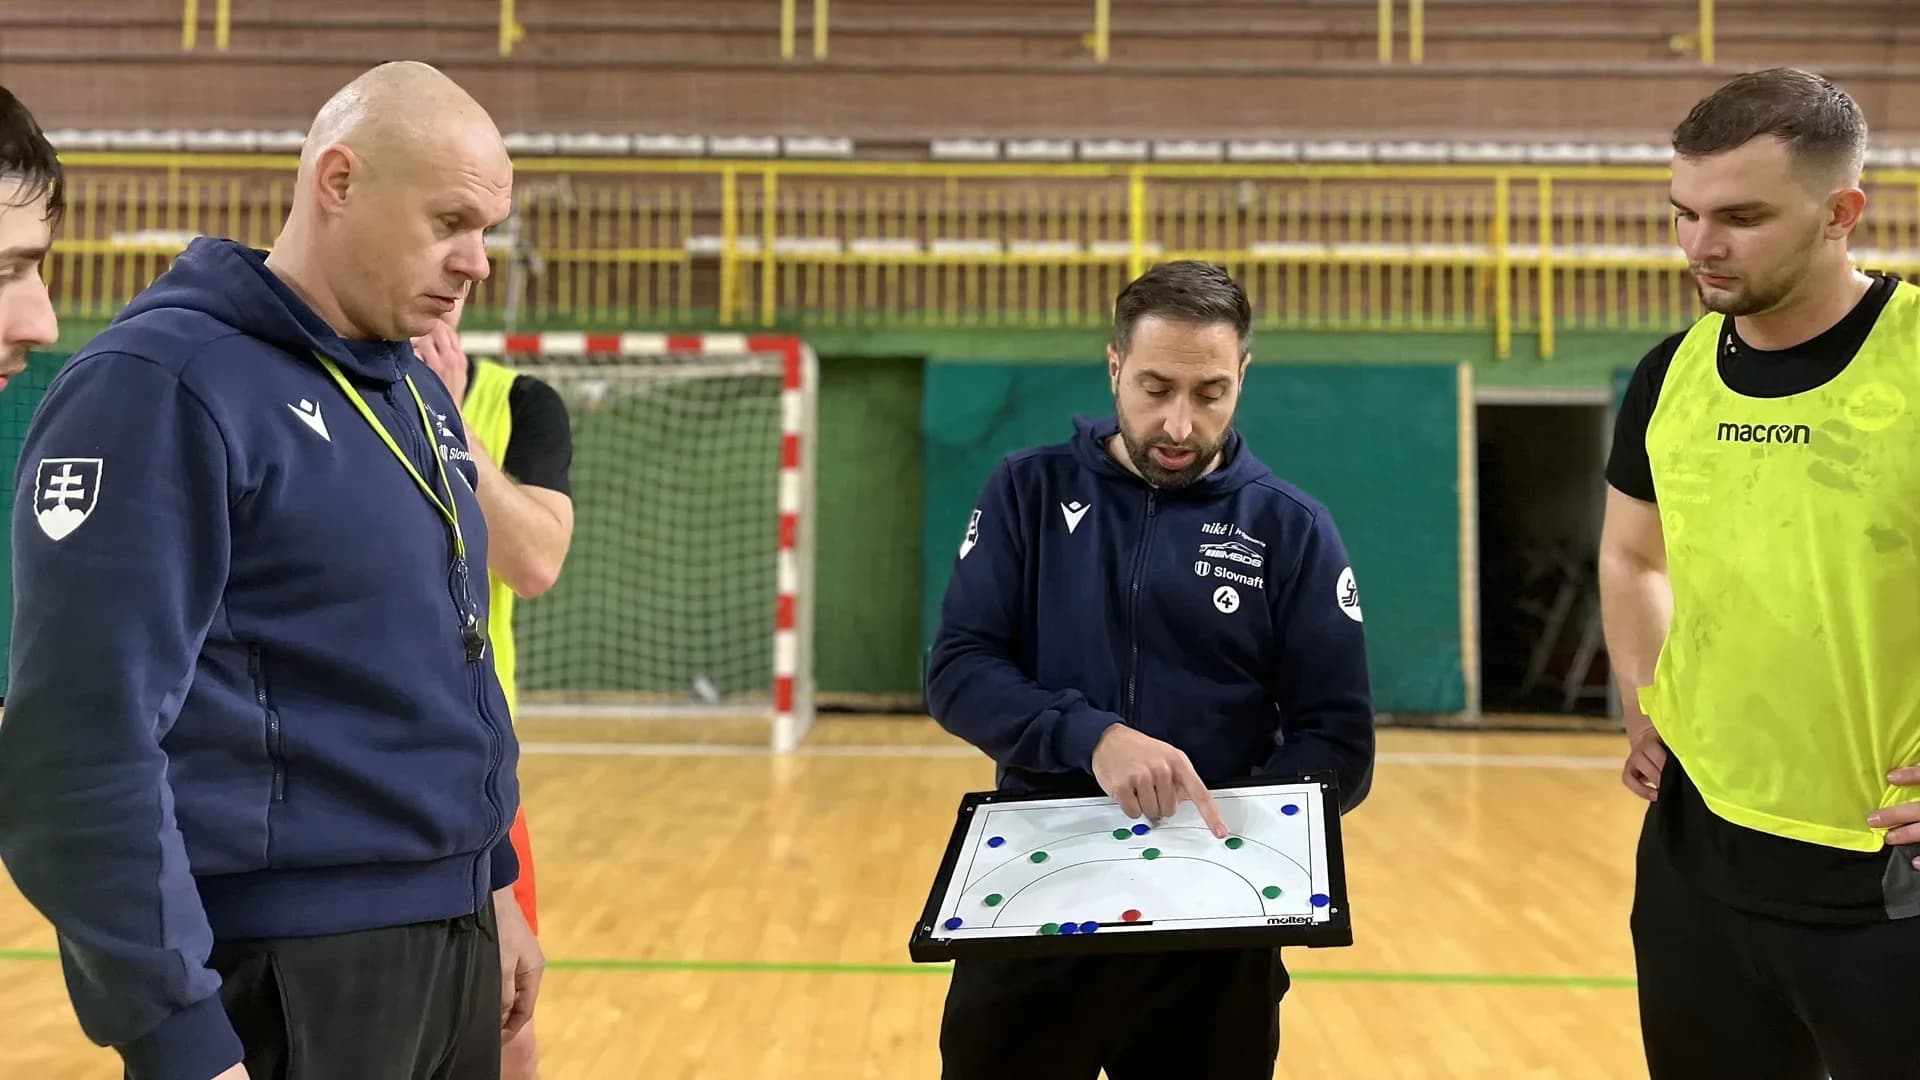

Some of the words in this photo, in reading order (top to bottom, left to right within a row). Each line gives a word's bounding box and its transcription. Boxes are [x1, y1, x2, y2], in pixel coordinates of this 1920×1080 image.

[1717, 422, 1810, 444] macron
[1213, 566, 1264, 589] Slovnaft
[1267, 916, 1314, 925] molten
